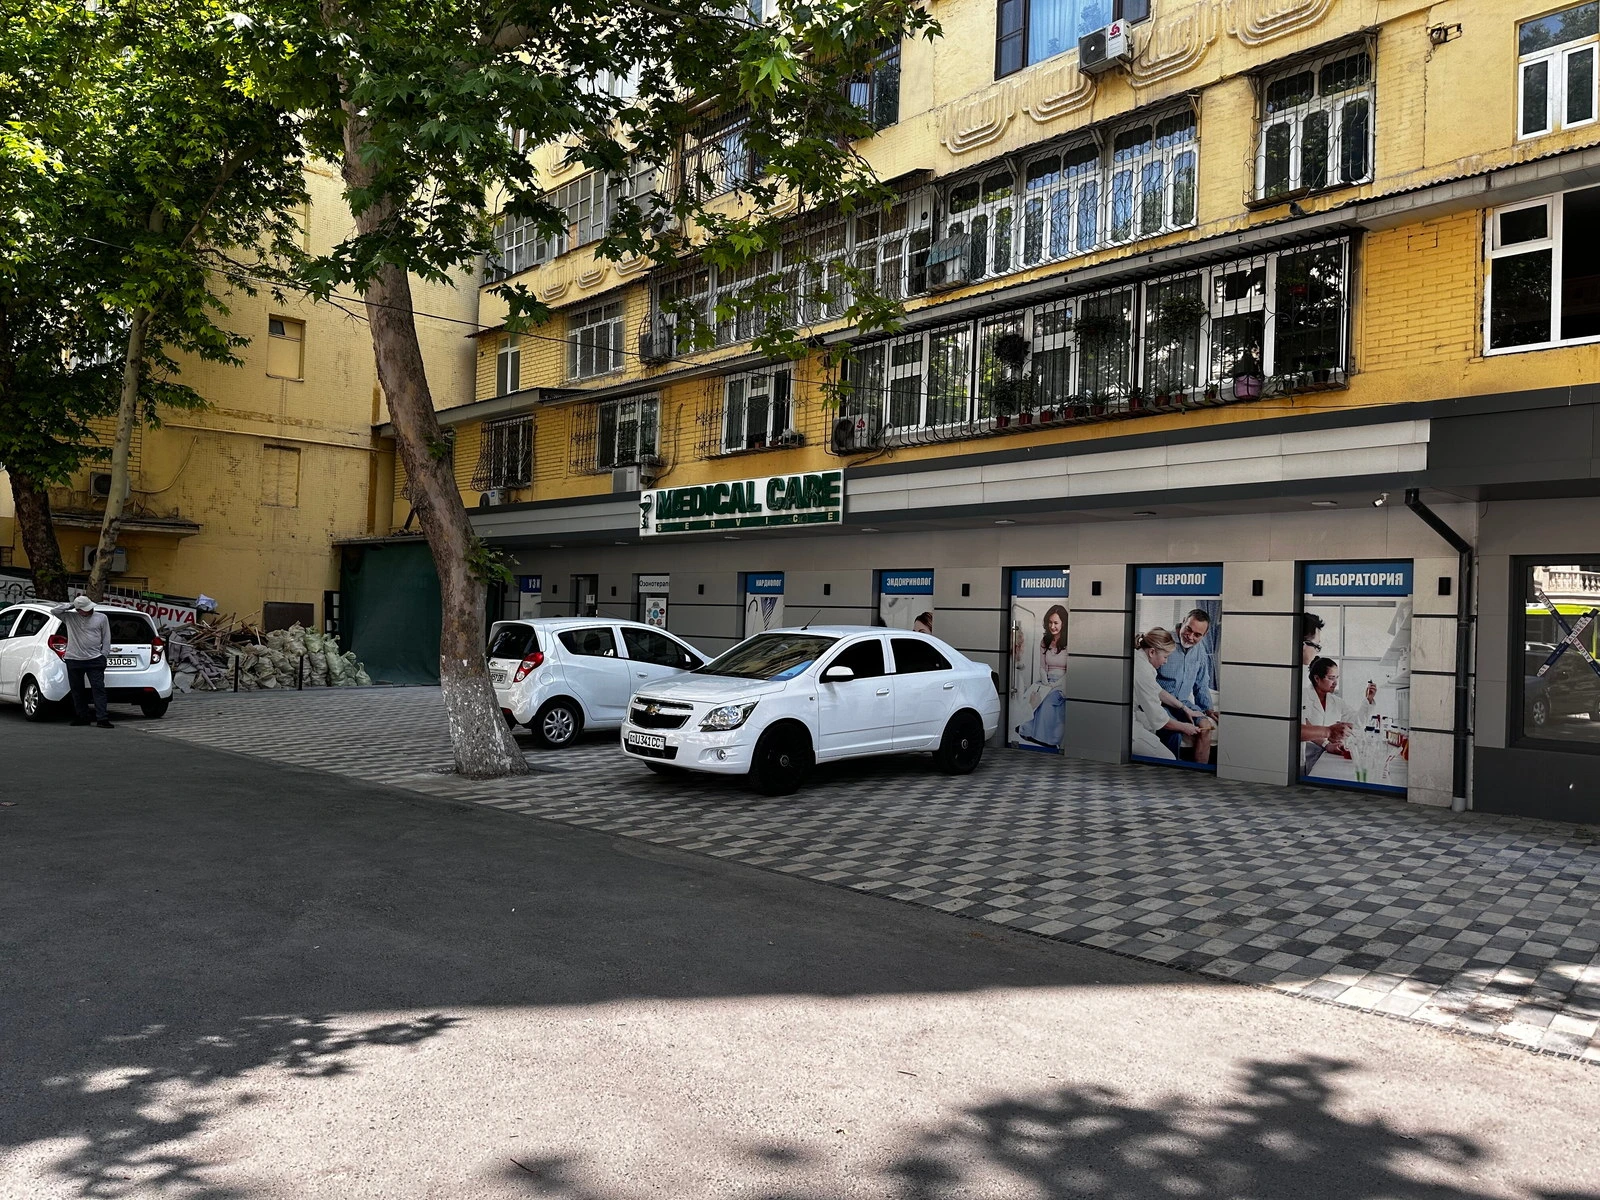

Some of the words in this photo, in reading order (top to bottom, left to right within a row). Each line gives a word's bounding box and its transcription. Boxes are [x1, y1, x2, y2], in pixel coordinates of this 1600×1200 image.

[655, 480, 762, 520] MEDICAL
[766, 472, 841, 511] CARE
[656, 511, 835, 532] SERVICE
[886, 577, 932, 587] ЭНДОКРИНОЛОГ
[1020, 577, 1067, 589] ГИНЕКОЛОГ
[1155, 573, 1207, 585] НЕВРОЛОГ
[1314, 572, 1404, 586] ЛАБОРАТОРИЯ
